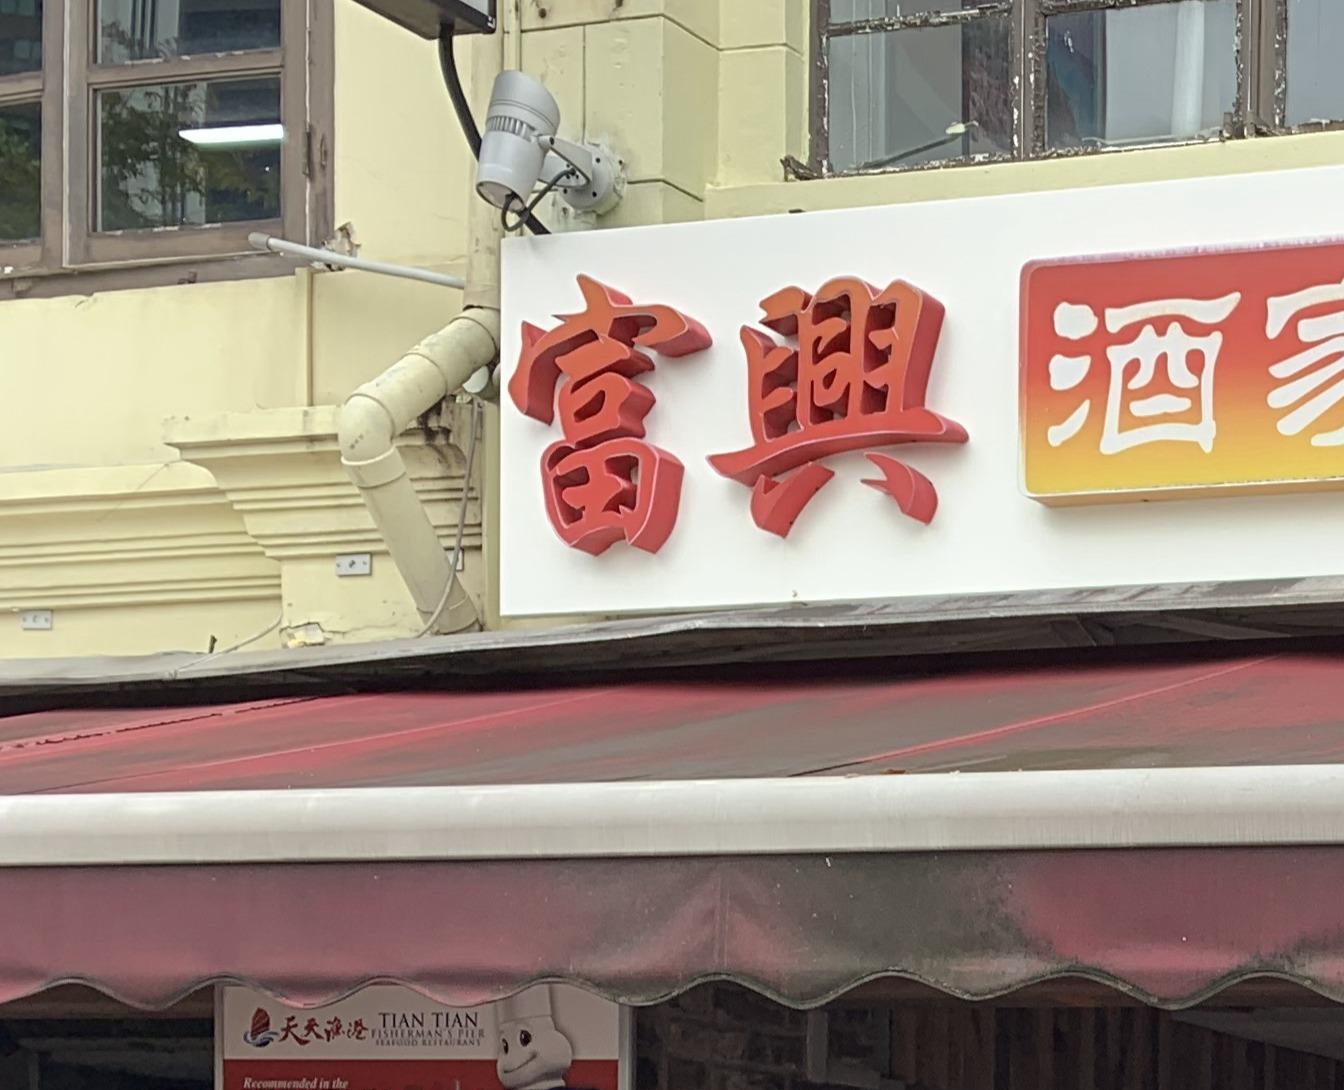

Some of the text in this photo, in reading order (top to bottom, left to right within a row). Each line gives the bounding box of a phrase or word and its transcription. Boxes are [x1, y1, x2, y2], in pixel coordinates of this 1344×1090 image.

[378, 1012, 478, 1028] TIAN TIAN
[458, 1029, 485, 1038] PIER
[243, 1077, 348, 1089] Recommended in the
